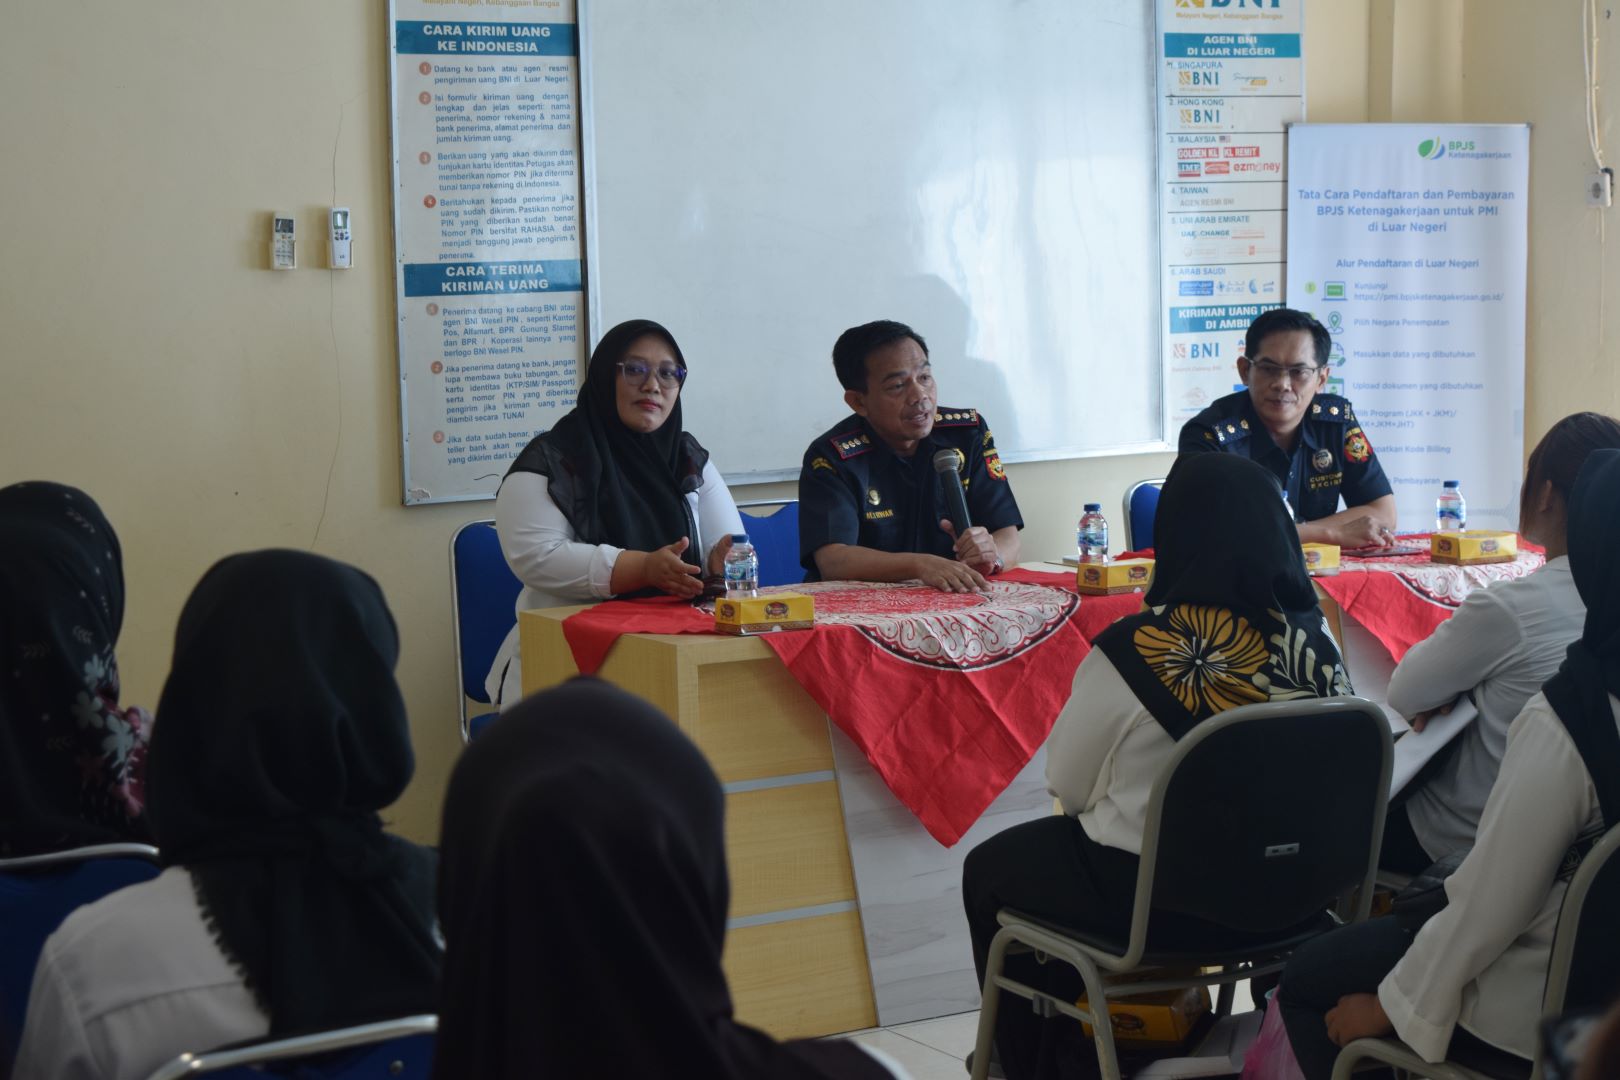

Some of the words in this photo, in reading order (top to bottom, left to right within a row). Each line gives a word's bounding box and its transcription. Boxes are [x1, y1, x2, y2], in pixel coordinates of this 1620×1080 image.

[424, 25, 462, 35] CARA
[467, 26, 507, 36] KIRIM
[512, 27, 550, 36] UANG
[438, 41, 456, 51] KE
[462, 41, 538, 52] INDONESIA
[435, 77, 476, 85] pengiriman
[1193, 72, 1218, 85] BNI
[436, 105, 464, 113] lengkap
[492, 104, 509, 112] jelas
[505, 114, 535, 122] rekening
[1194, 110, 1219, 123] BNI
[520, 124, 553, 132] penerima
[437, 136, 461, 144] jumlah
[1449, 142, 1475, 150] BPJS
[1449, 152, 1511, 160] Ketenagakerjaan
[562, 195, 574, 203] jika
[1298, 190, 1320, 199] Tata
[1324, 190, 1349, 199] Cara
[1353, 190, 1419, 199] Pendaftaran
[1423, 190, 1443, 199] dan
[1448, 190, 1514, 201] Pembayaran
[1317, 206, 1344, 216] BPJS
[1348, 206, 1439, 217] Ketenagakerjaan
[1443, 206, 1474, 216] untuk
[1478, 206, 1498, 215] PMI
[490, 227, 517, 235] bersifat
[1368, 222, 1378, 232] di
[1382, 223, 1406, 232] Luar
[1410, 222, 1447, 233] Negeri
[1336, 260, 1355, 268] Alur
[1358, 260, 1412, 268] Pendaftaran
[1415, 260, 1423, 268] di
[1426, 260, 1446, 268] Luar
[1449, 260, 1479, 269] Negeri
[446, 266, 486, 277] CARA
[490, 265, 543, 275] TERIMA
[442, 281, 504, 292] KIRIMAN
[509, 279, 548, 290] UANG
[1179, 308, 1225, 318] KIRIMAN
[1229, 306, 1258, 315] UANG
[1206, 321, 1216, 329] DI
[1191, 343, 1219, 358] BNI
[462, 364, 494, 373] penerima
[553, 359, 575, 367] jangan
[447, 406, 477, 414] pengirim
[483, 404, 496, 412] jika
[503, 412, 524, 420] TUNAI
